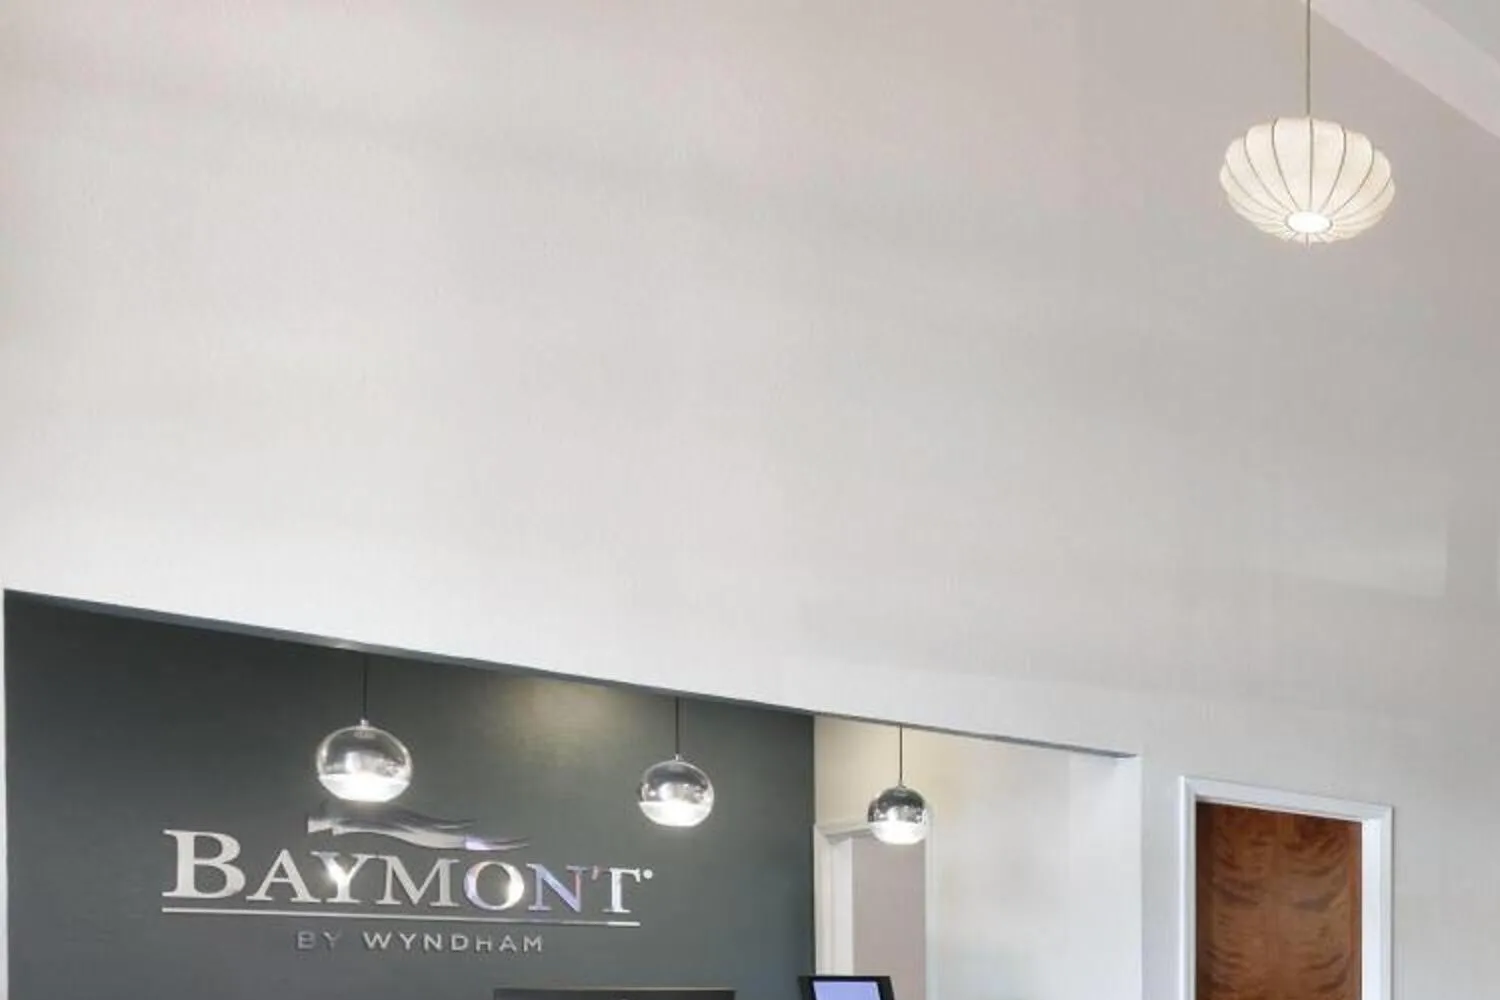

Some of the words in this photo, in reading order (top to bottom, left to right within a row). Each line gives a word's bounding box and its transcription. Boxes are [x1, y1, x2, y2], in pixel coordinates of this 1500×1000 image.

[162, 828, 642, 914] BAYMONT
[297, 931, 343, 950] BY
[362, 931, 544, 953] WYNDHAM
